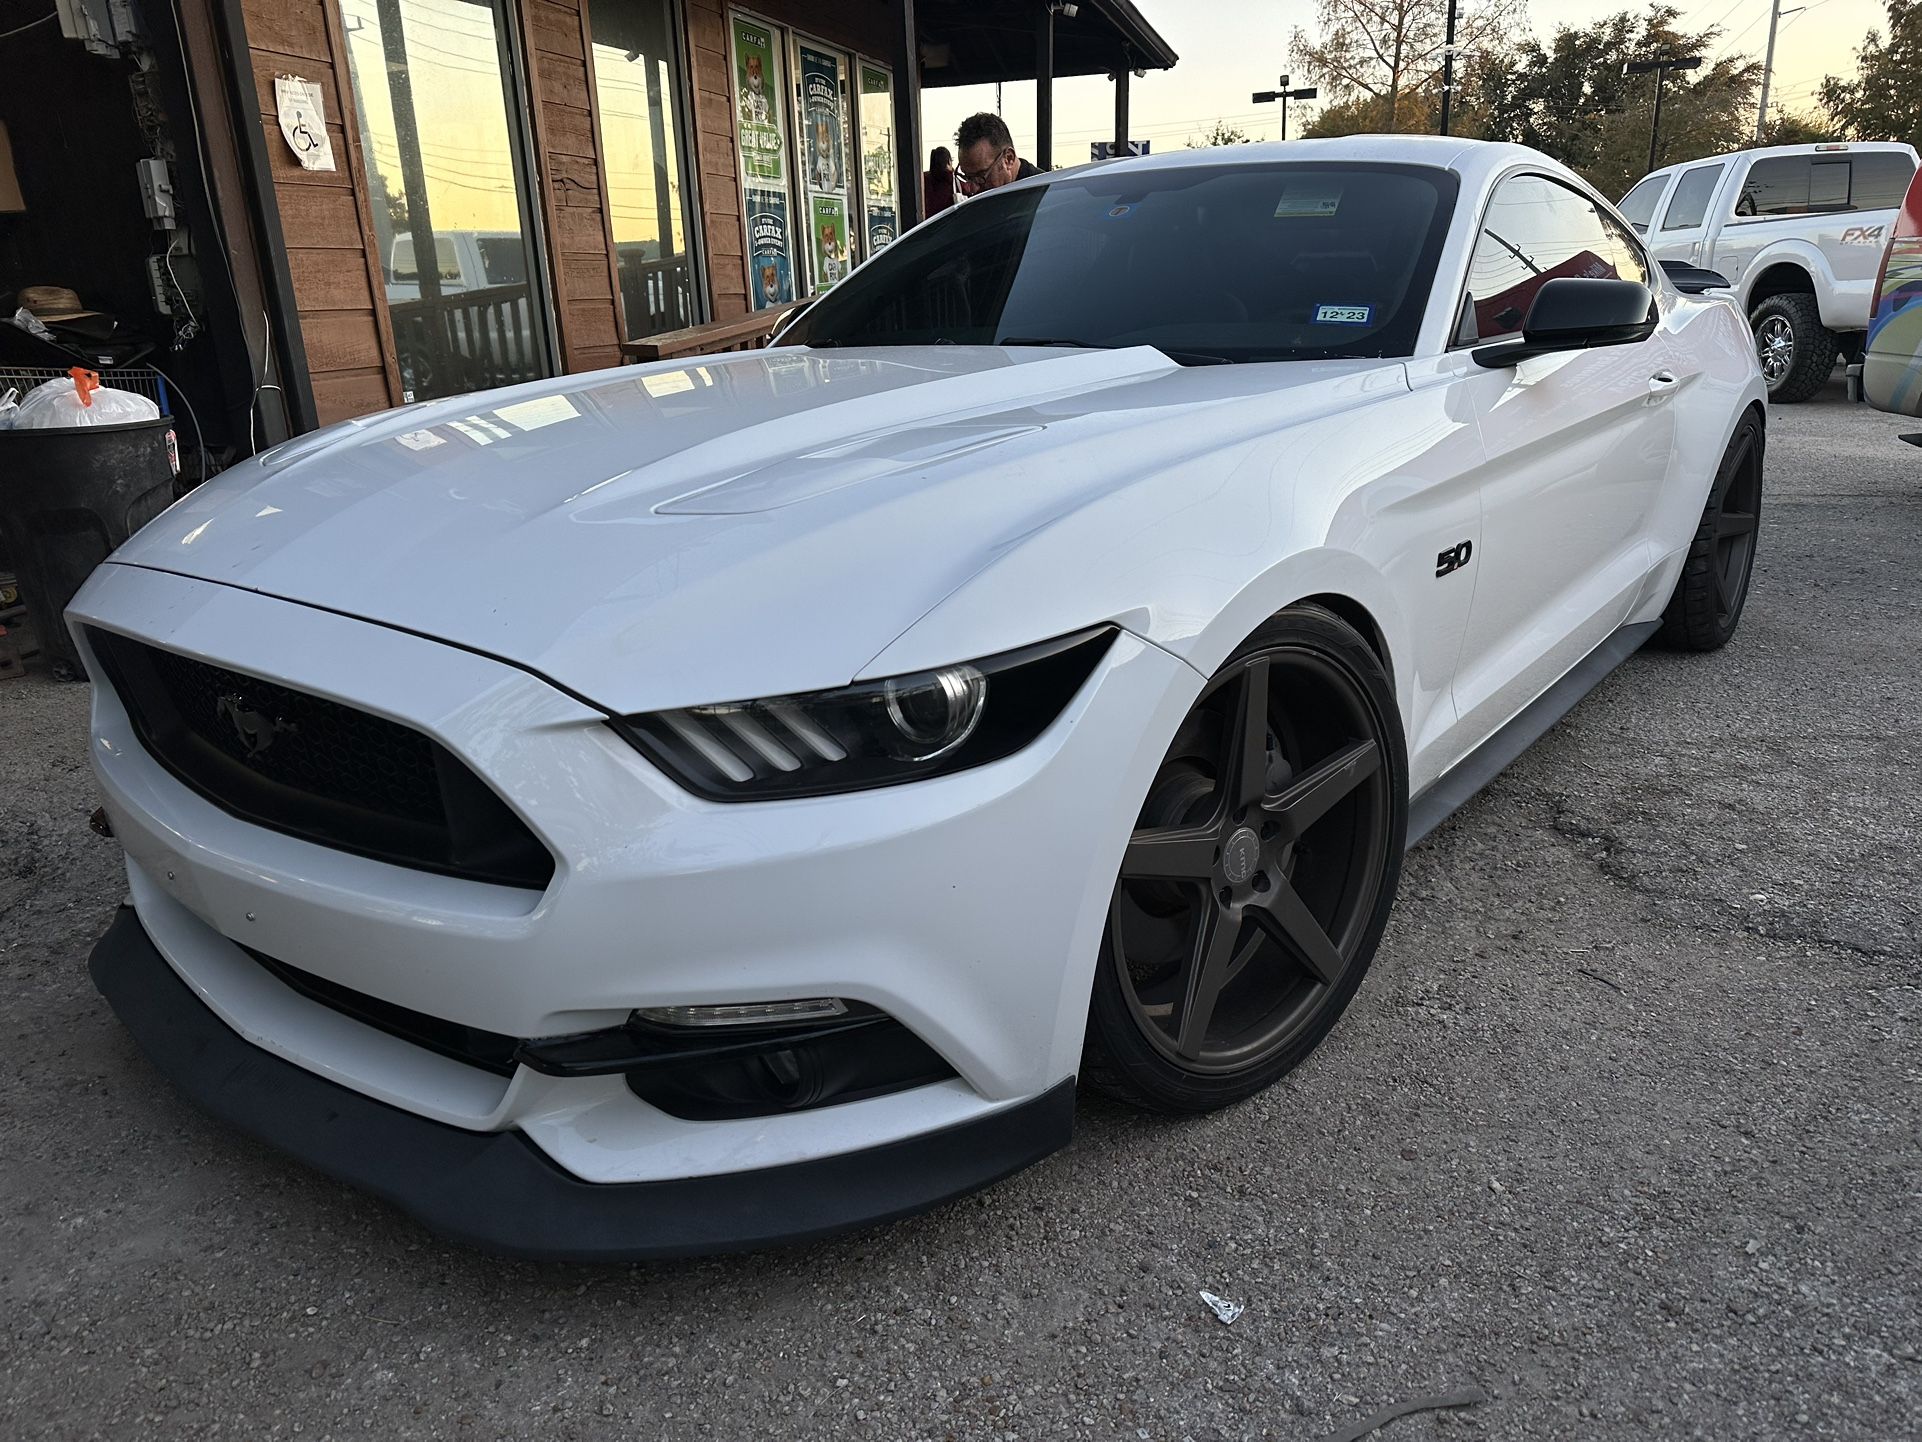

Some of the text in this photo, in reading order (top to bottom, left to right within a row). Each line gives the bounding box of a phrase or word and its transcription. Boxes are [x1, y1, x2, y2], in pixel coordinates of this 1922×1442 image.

[809, 84, 833, 100] CARFAX
[741, 130, 758, 148] GREAT
[755, 225, 782, 239] CARFAX
[1841, 225, 1885, 242] FX4
[1322, 311, 1365, 320] 12 23
[1435, 539, 1472, 578] 5.0
